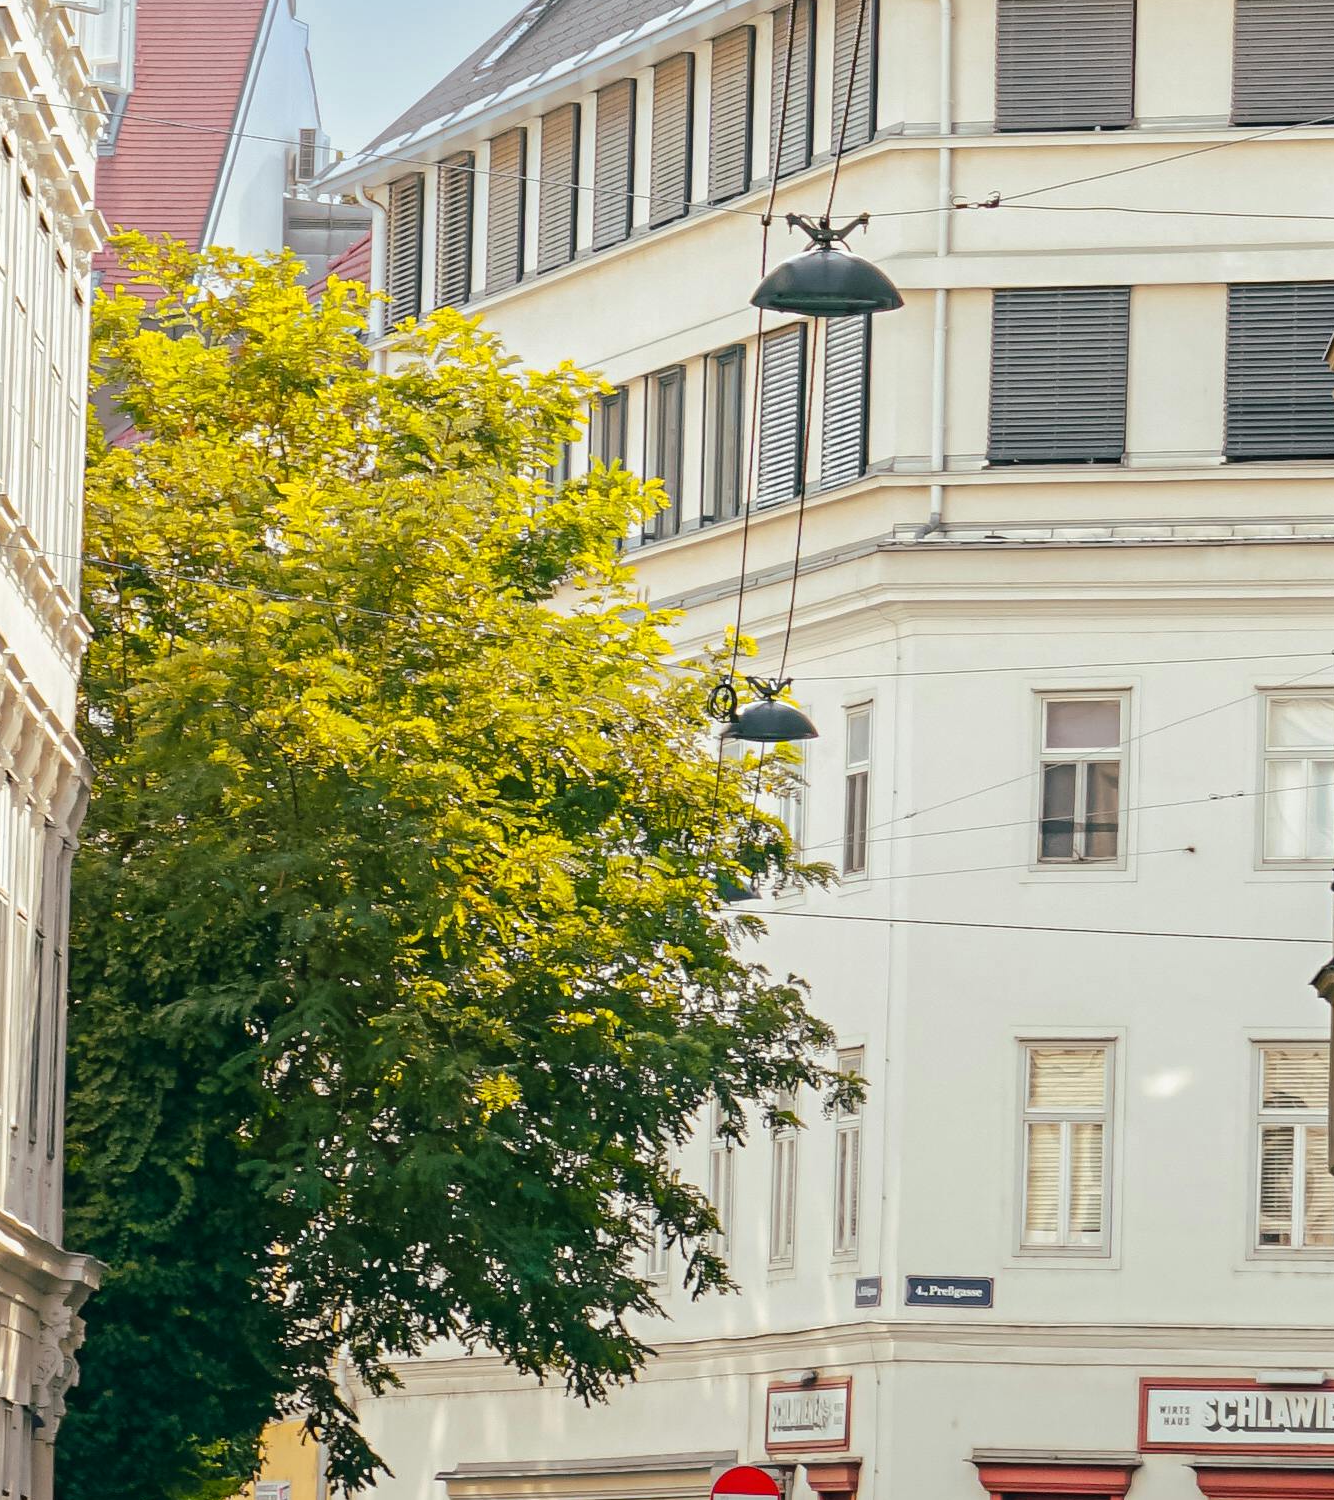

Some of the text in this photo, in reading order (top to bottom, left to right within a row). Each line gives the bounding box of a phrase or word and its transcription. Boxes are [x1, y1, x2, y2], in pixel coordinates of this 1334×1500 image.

[928, 1285, 983, 1299] Preßgasse
[1159, 1405, 1191, 1415] WIRTS
[1163, 1416, 1191, 1426] HAUS
